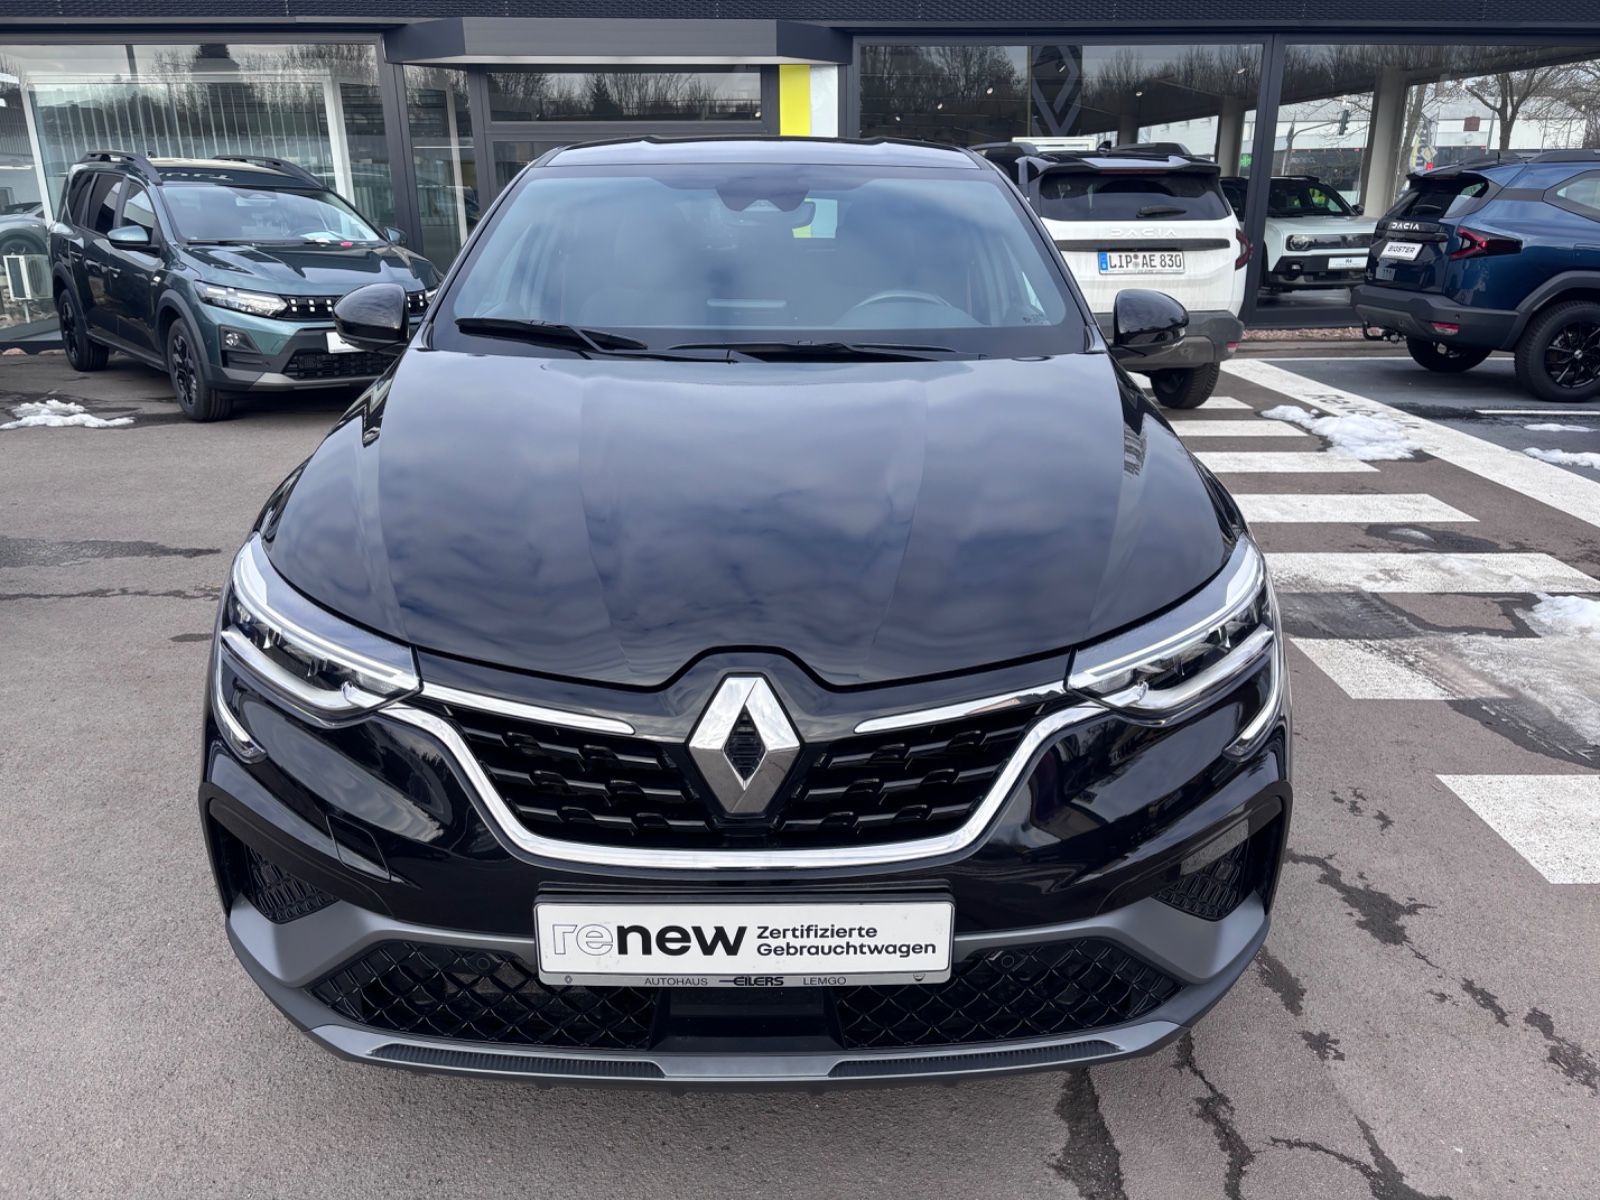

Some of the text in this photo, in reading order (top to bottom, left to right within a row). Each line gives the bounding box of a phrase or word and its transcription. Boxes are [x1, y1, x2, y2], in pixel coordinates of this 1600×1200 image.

[1391, 222, 1420, 231] DACIA
[1108, 253, 1182, 269] LIP AE 830
[756, 924, 878, 940] Zertifizierte
[552, 924, 748, 957] renew
[756, 941, 937, 958] Gebrauchtwagen
[644, 976, 847, 987] AUTOHAUS EILERS LEMGO
